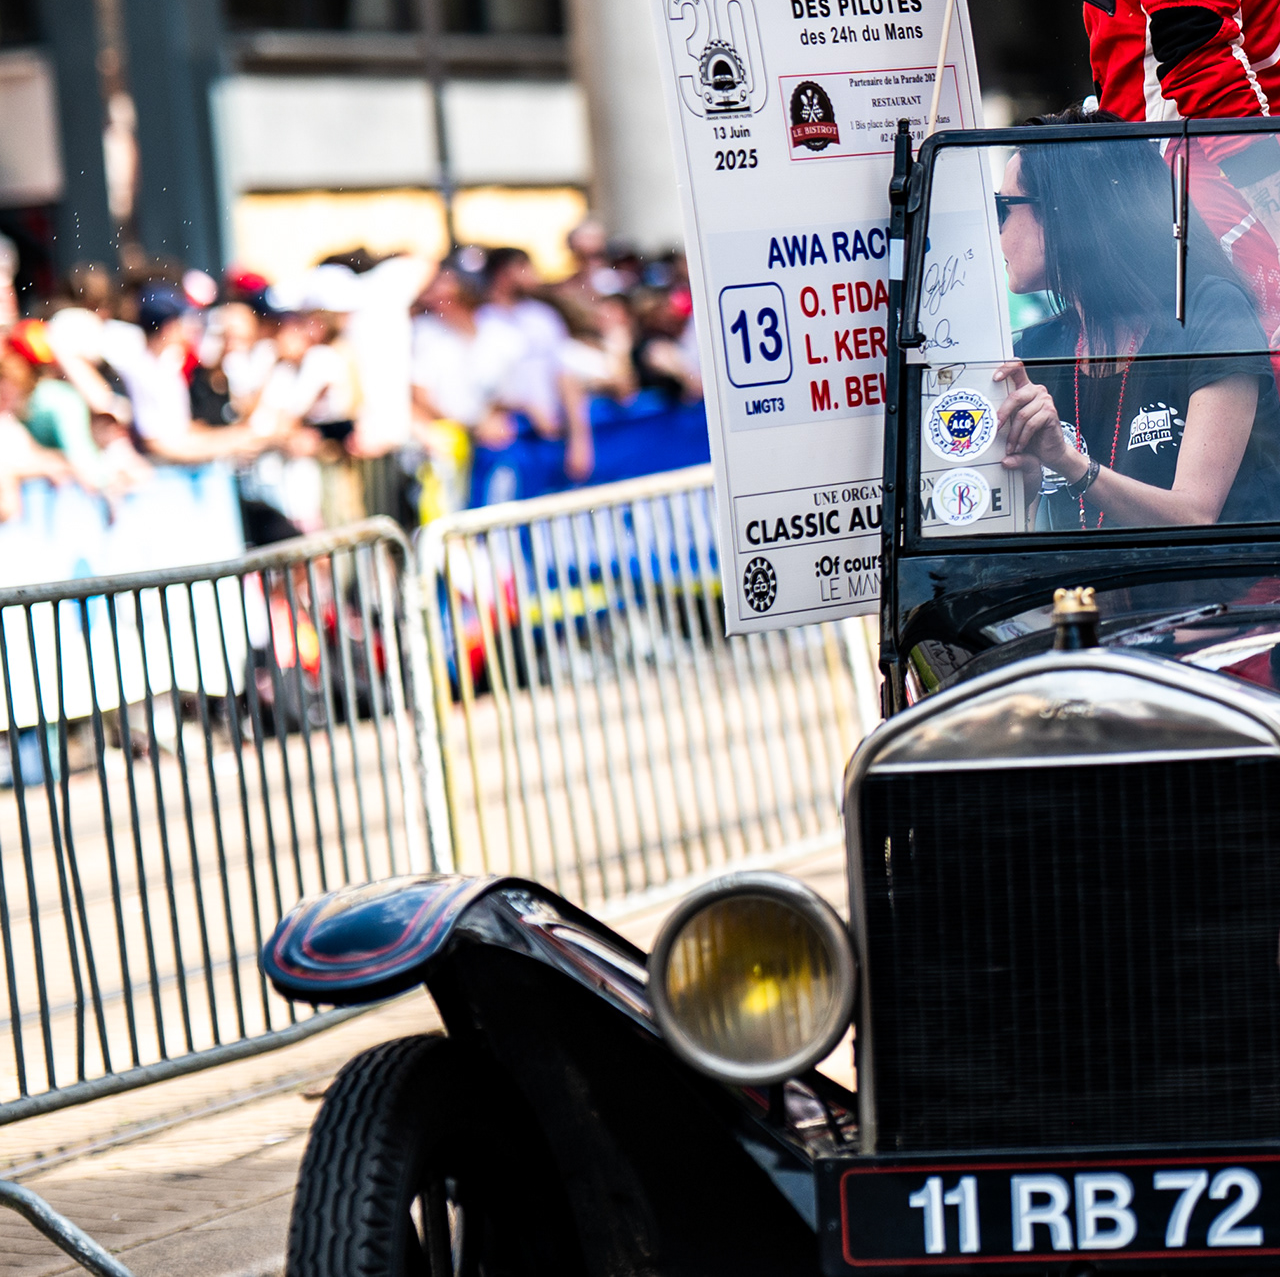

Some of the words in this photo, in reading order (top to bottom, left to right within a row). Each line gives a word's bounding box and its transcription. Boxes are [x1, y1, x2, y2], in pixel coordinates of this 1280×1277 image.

[800, 27, 826, 46] des
[830, 26, 858, 44] 24h
[862, 24, 880, 42] du
[885, 23, 923, 41] Mans
[849, 76, 883, 87] Partenaire
[884, 77, 892, 85] de
[893, 76, 900, 84] la
[900, 74, 923, 84] Parade
[924, 73, 936, 83] 202
[872, 95, 921, 107] RESTAURANT
[713, 127, 726, 139] 13
[730, 125, 750, 138] Juin
[793, 127, 803, 137] LE
[804, 125, 838, 135] BISTROT
[856, 120, 866, 130] Bis
[868, 119, 883, 131] place
[884, 118, 895, 128] des
[714, 149, 758, 170] 2025
[768, 233, 828, 269] AWA
[800, 286, 826, 318] O.
[832, 279, 889, 315] FIDA
[730, 306, 783, 365] 13
[805, 333, 828, 365] L.
[834, 326, 888, 362] KER
[810, 379, 839, 412] M.
[745, 397, 785, 416] LMGT3
[951, 439, 971, 452] 24
[813, 490, 839, 506] UNE
[745, 509, 840, 545] CLASSIC
[844, 554, 883, 573] cours
[820, 577, 841, 602] LE
[848, 573, 882, 598] MAN
[909, 1175, 980, 1254] 11
[1010, 1171, 1138, 1252] RB
[1153, 1167, 1265, 1248] 72
